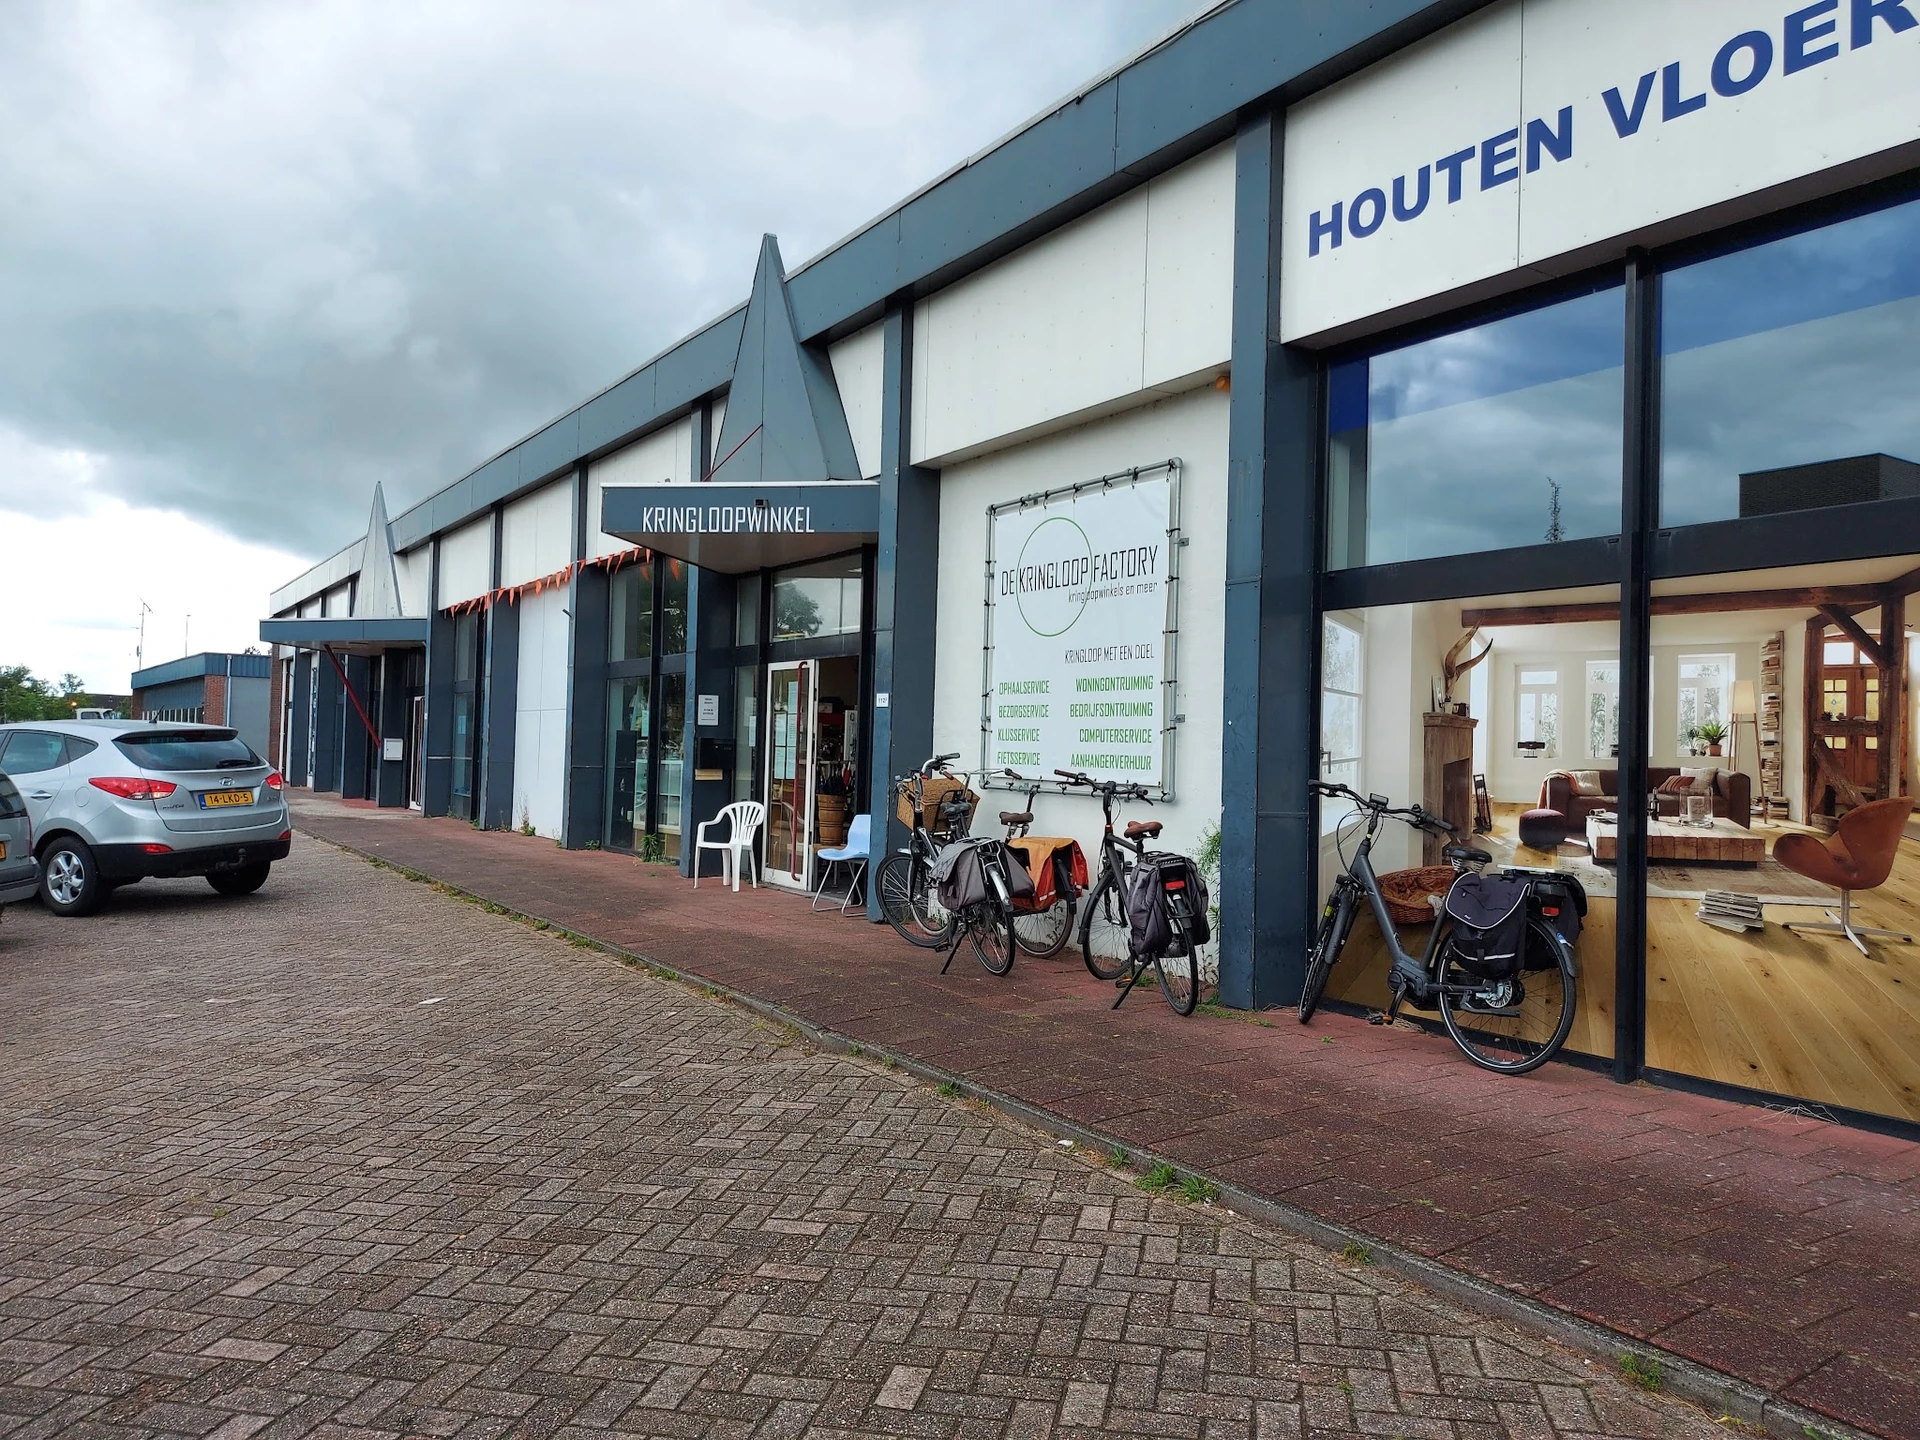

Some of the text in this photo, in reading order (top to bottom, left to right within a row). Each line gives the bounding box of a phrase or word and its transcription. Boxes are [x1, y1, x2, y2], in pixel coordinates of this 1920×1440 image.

[1308, 105, 1573, 258] HOUTEN
[642, 506, 815, 533] KRINGLOOPWINKEL
[1001, 544, 1158, 596] DE KRINGLOOP FACTORY
[1068, 582, 1158, 604] kringloopwinkels en meer
[1065, 643, 1155, 664] KRINGLOOP MET EEN DOEL
[999, 680, 1050, 695] OPHAALSERVICE
[1075, 675, 1154, 693] WONINGONTRUIMING
[998, 704, 1049, 718] BEZORGSERVICE
[1069, 702, 1153, 718] BEDRIJFSONTRUIMING
[997, 728, 1040, 742] KLUSSERVICE
[1079, 728, 1152, 744] COMPUTERSERVICE
[997, 751, 1040, 766] FIETSSERVICE
[1070, 753, 1152, 770] AANHANGERVERHUUR
[209, 793, 249, 805] 14-LKD-5
